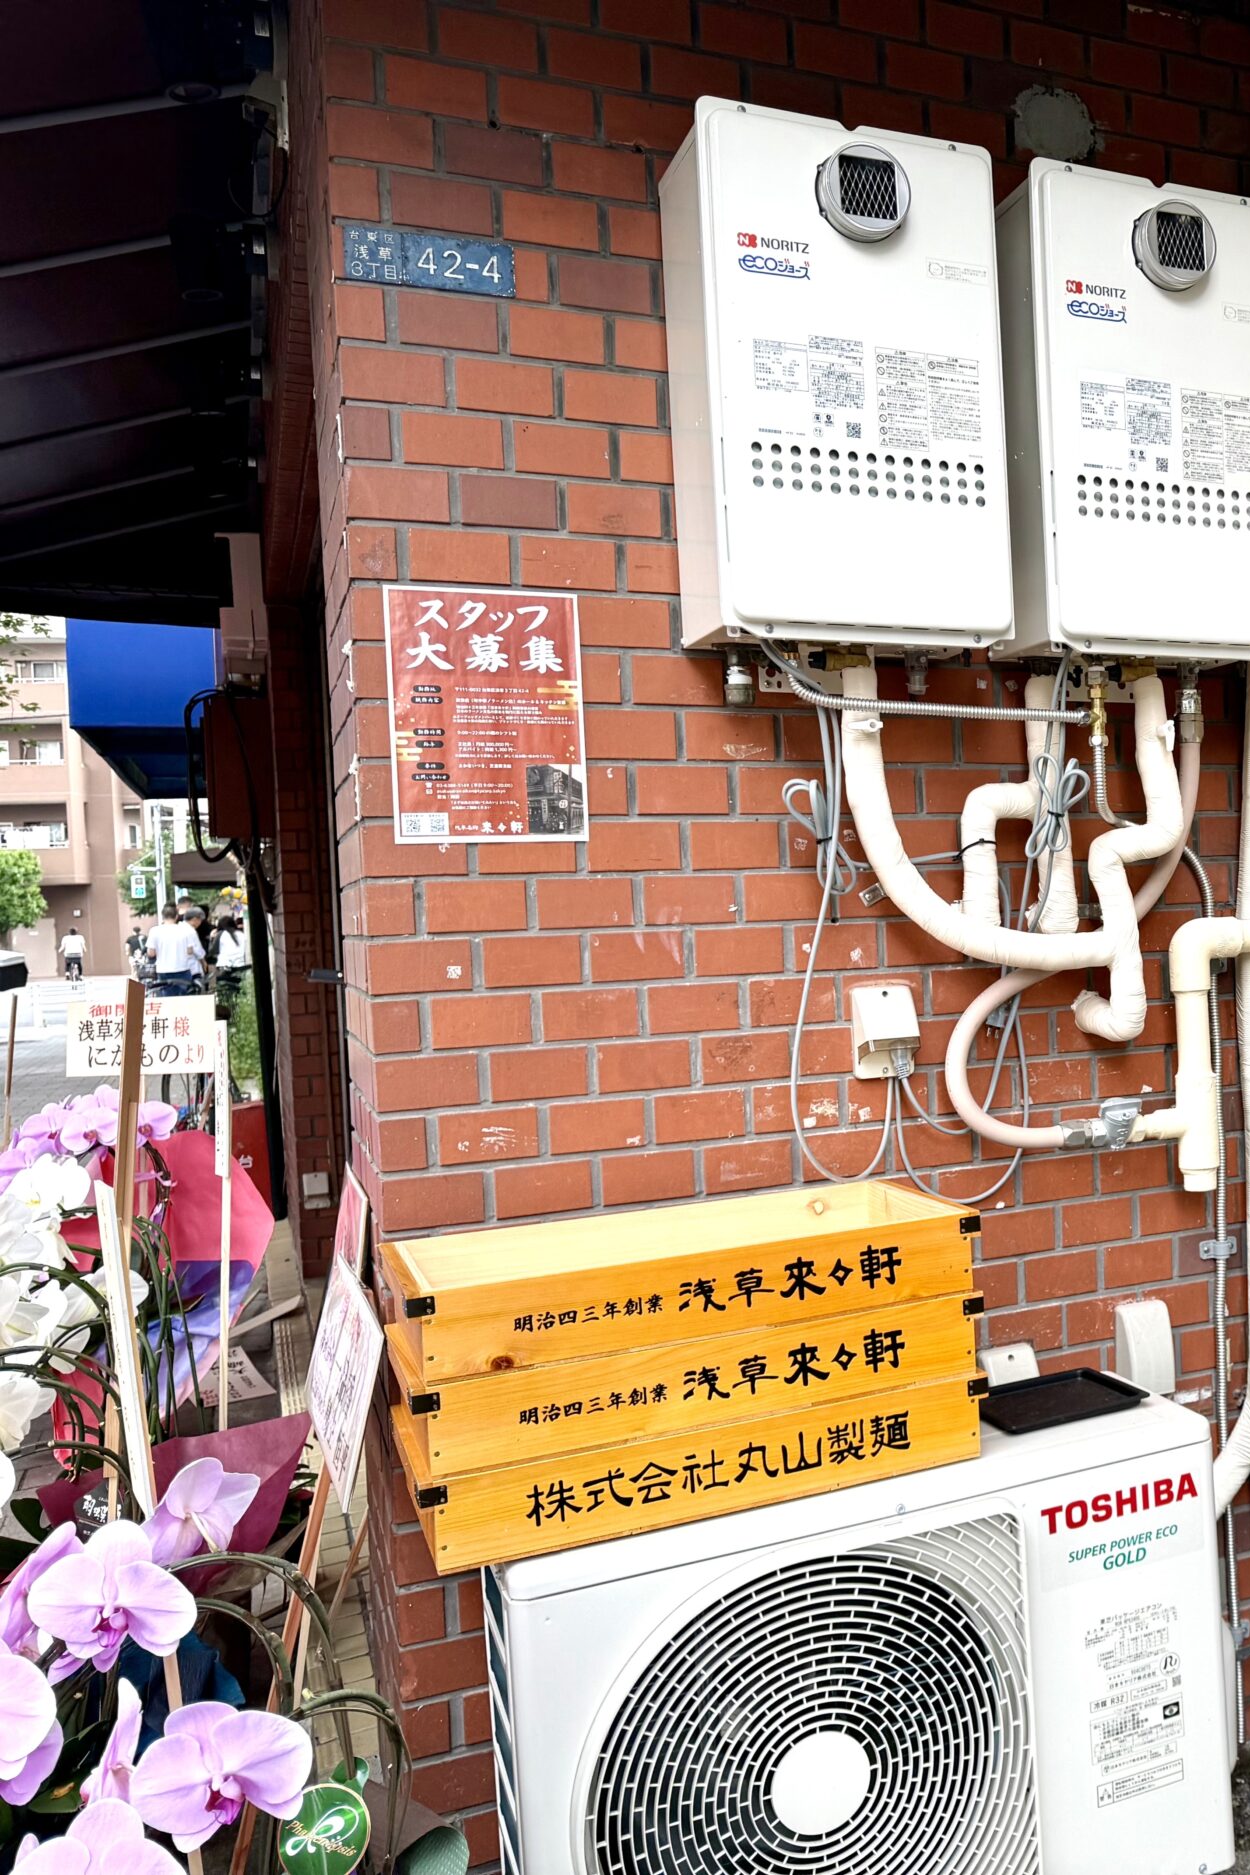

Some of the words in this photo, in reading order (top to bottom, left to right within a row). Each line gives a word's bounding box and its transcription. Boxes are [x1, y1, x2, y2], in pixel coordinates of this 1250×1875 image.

[349, 231, 395, 244] 台東区
[354, 244, 392, 261] 浅草
[761, 237, 810, 254] NORITZ
[351, 261, 397, 280] 3丁目
[417, 247, 502, 284] 42-4
[1085, 284, 1127, 299] NORITZ
[414, 599, 549, 633] スタッフ
[406, 631, 564, 674] 大募集
[513, 1293, 664, 1332] 明治四三年創業
[518, 1383, 669, 1425] 明治四三年創業
[526, 1410, 912, 1527] 株式会社丸山製麺
[1040, 1472, 1198, 1535] TOSHIBA
[1068, 1543, 1107, 1563] SUPER
[1110, 1531, 1153, 1552] POWER
[1155, 1524, 1178, 1540] ECO
[1103, 1547, 1147, 1571] GOLD
